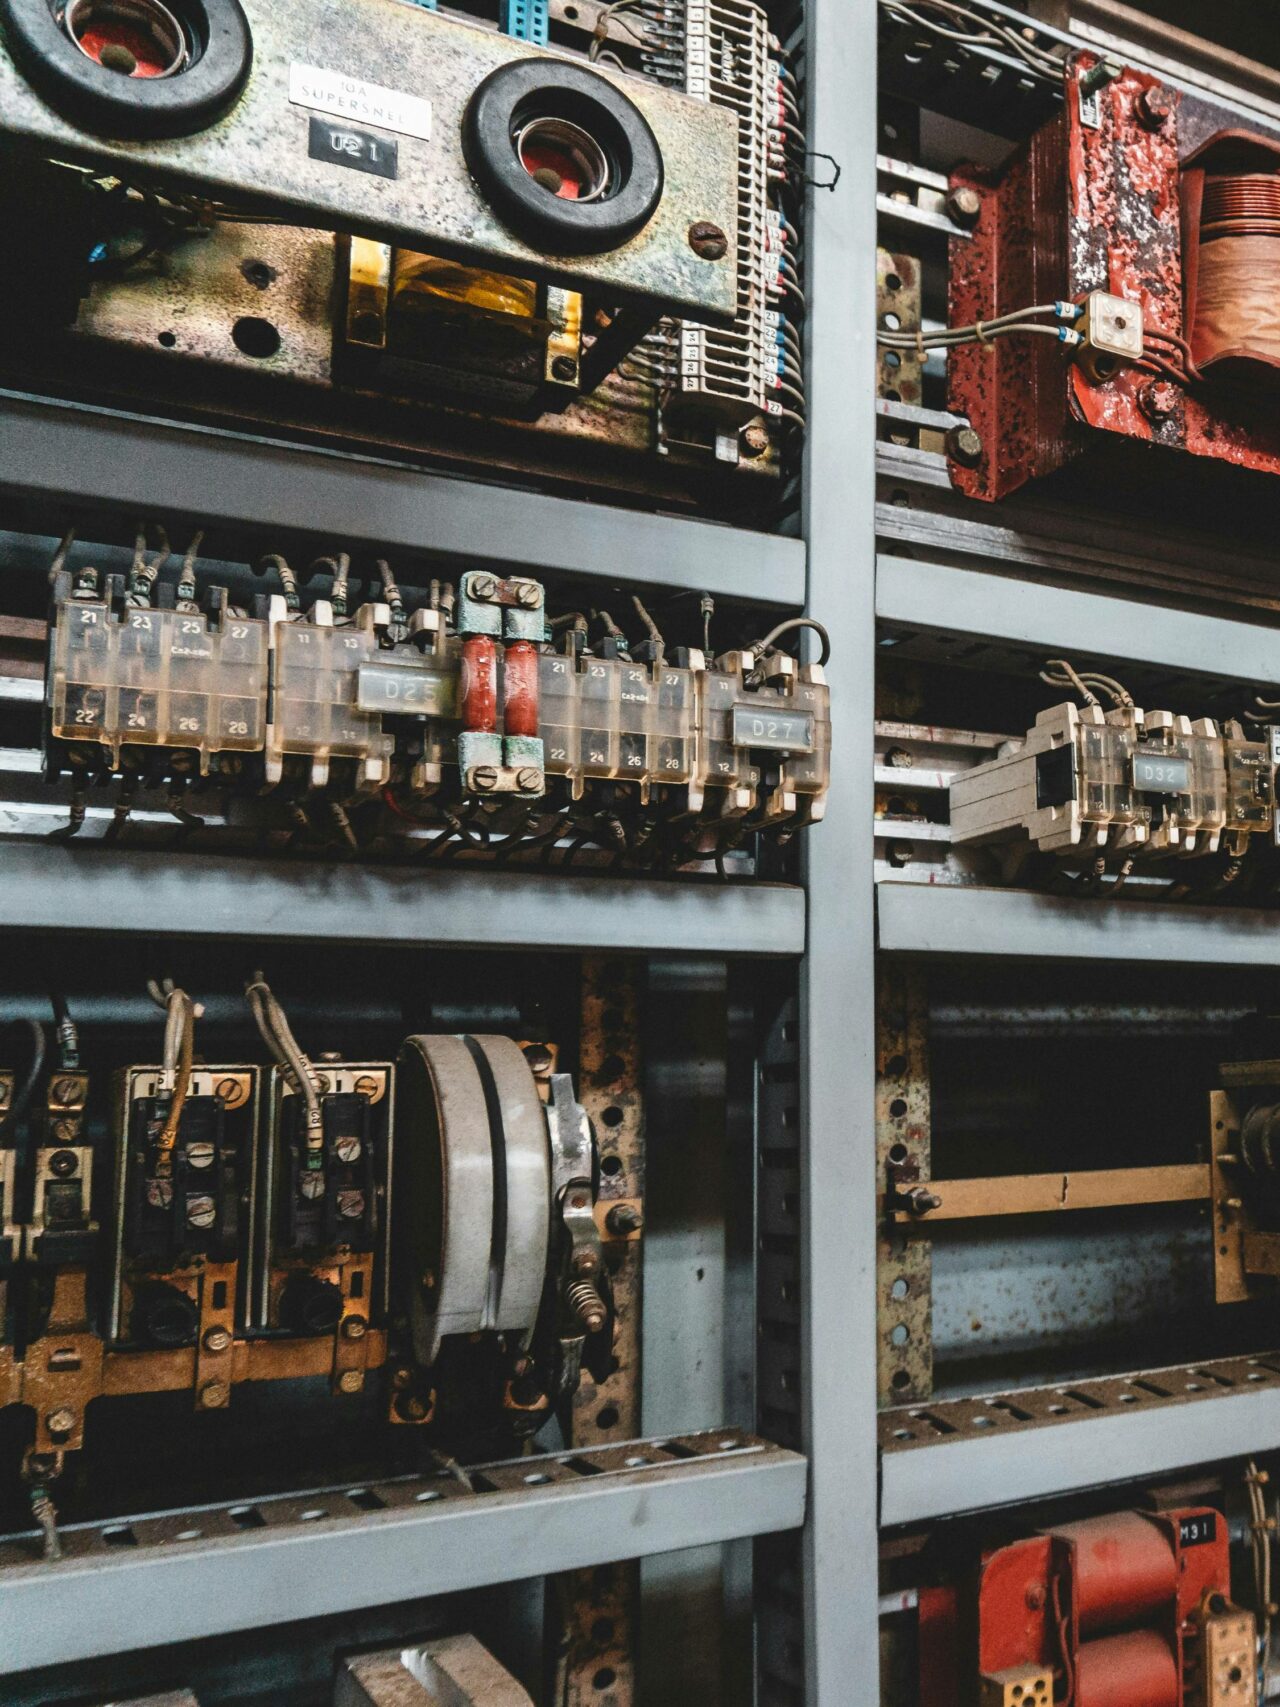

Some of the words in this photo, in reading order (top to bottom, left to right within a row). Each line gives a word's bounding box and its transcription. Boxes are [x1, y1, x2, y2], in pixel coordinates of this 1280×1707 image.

[765, 312, 777, 321] 21
[765, 329, 776, 338] 22
[770, 403, 780, 413] 27
[81, 610, 97, 623] 21
[132, 616, 152, 630] 23
[182, 621, 201, 634] 25
[231, 626, 249, 639] 27
[297, 634, 310, 644] 11
[343, 638, 358, 649] 13
[552, 662, 565, 673] 21
[591, 666, 606, 678] 23
[628, 670, 643, 682] 25
[665, 675, 680, 686] 27
[719, 681, 728, 690] 11
[75, 709, 95, 724] 22
[128, 713, 146, 727] 24
[179, 717, 199, 731] 26
[228, 721, 248, 735] 28
[752, 719, 793, 739] D27
[550, 749, 566, 760] 22
[589, 752, 604, 763] 24
[627, 755, 642, 766] 26
[665, 758, 680, 769] 28
[718, 763, 730, 772] 12
[1144, 766, 1175, 783] D32
[1180, 1522, 1207, 1539] M31
